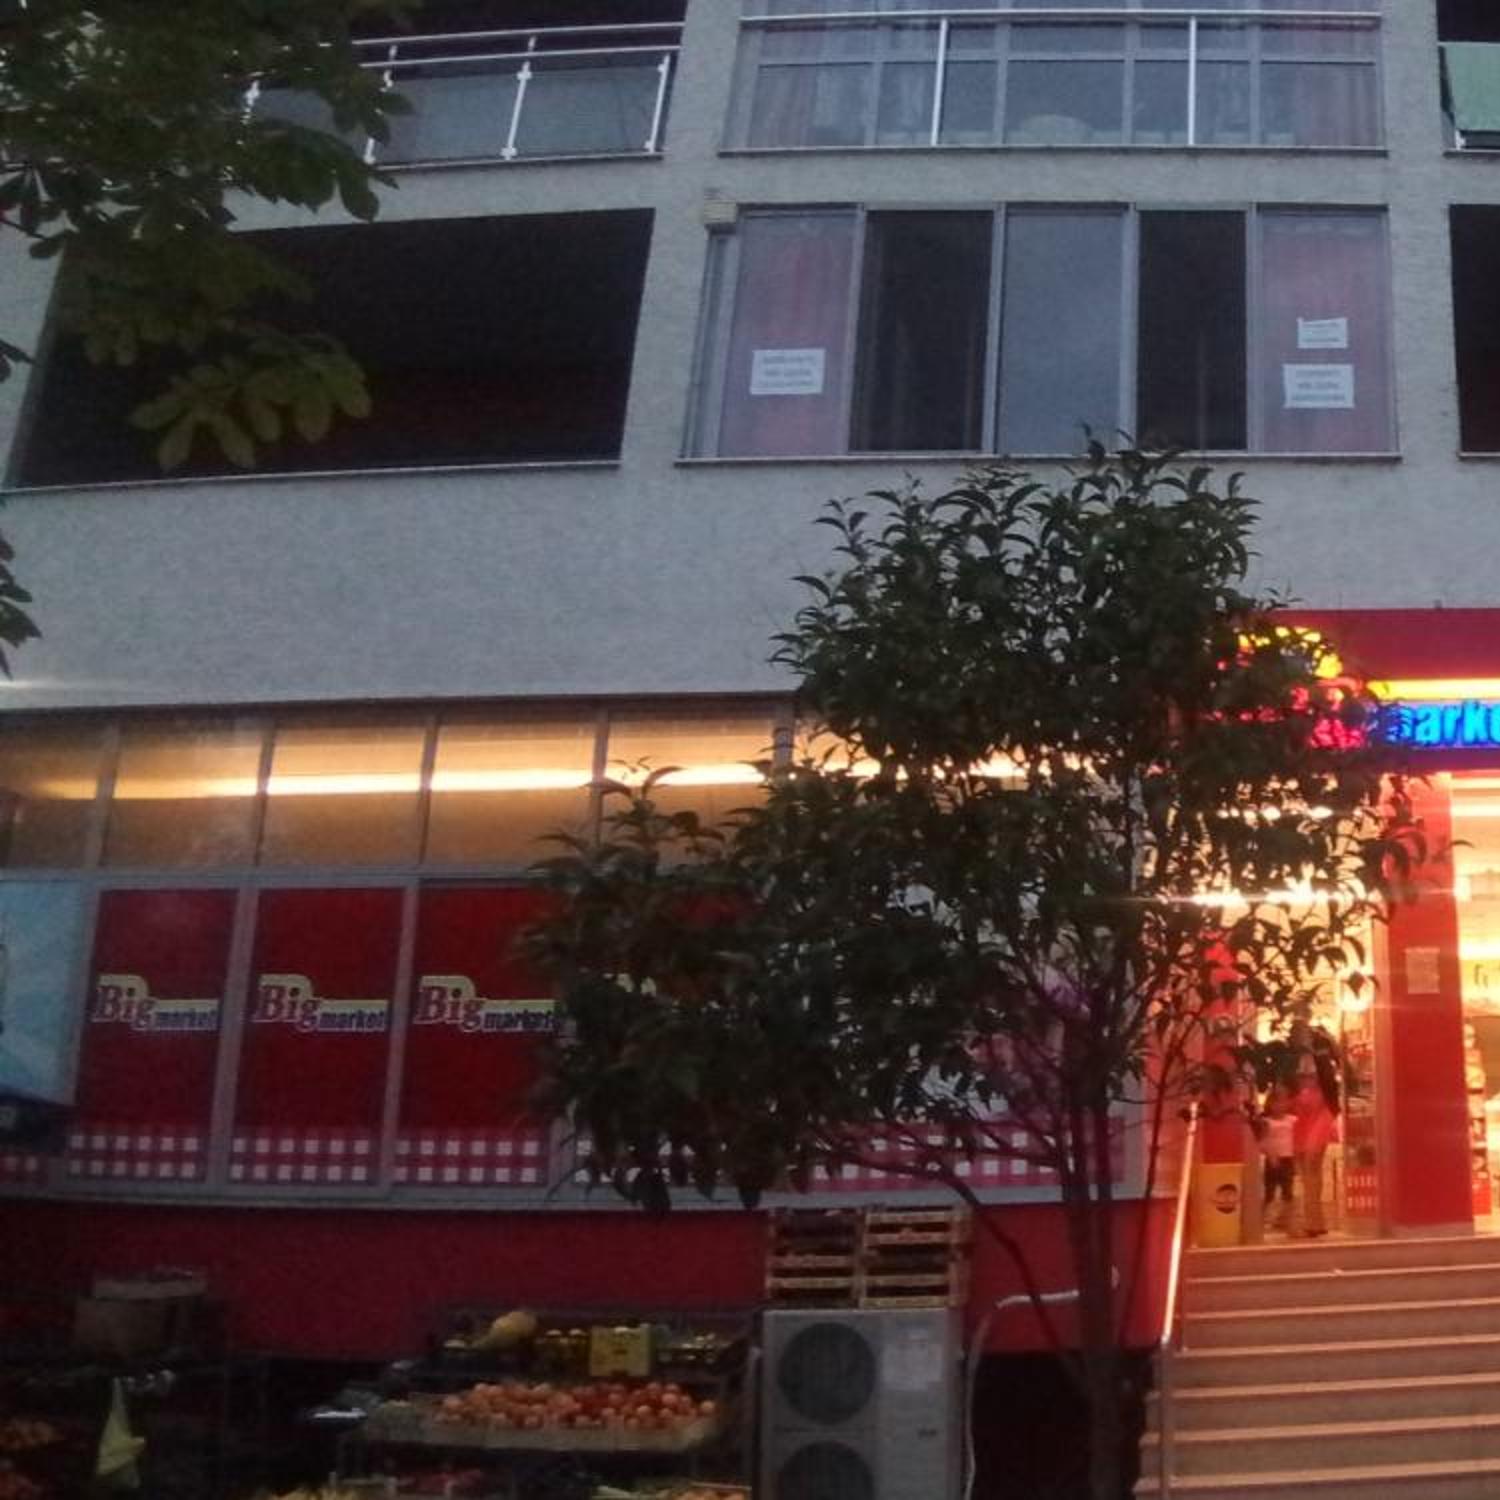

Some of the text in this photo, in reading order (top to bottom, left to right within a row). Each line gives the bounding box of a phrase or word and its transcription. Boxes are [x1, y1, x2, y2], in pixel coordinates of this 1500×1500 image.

[94, 985, 218, 1031] Big market
[254, 985, 387, 1032] Big market
[414, 986, 557, 1032] Big market
